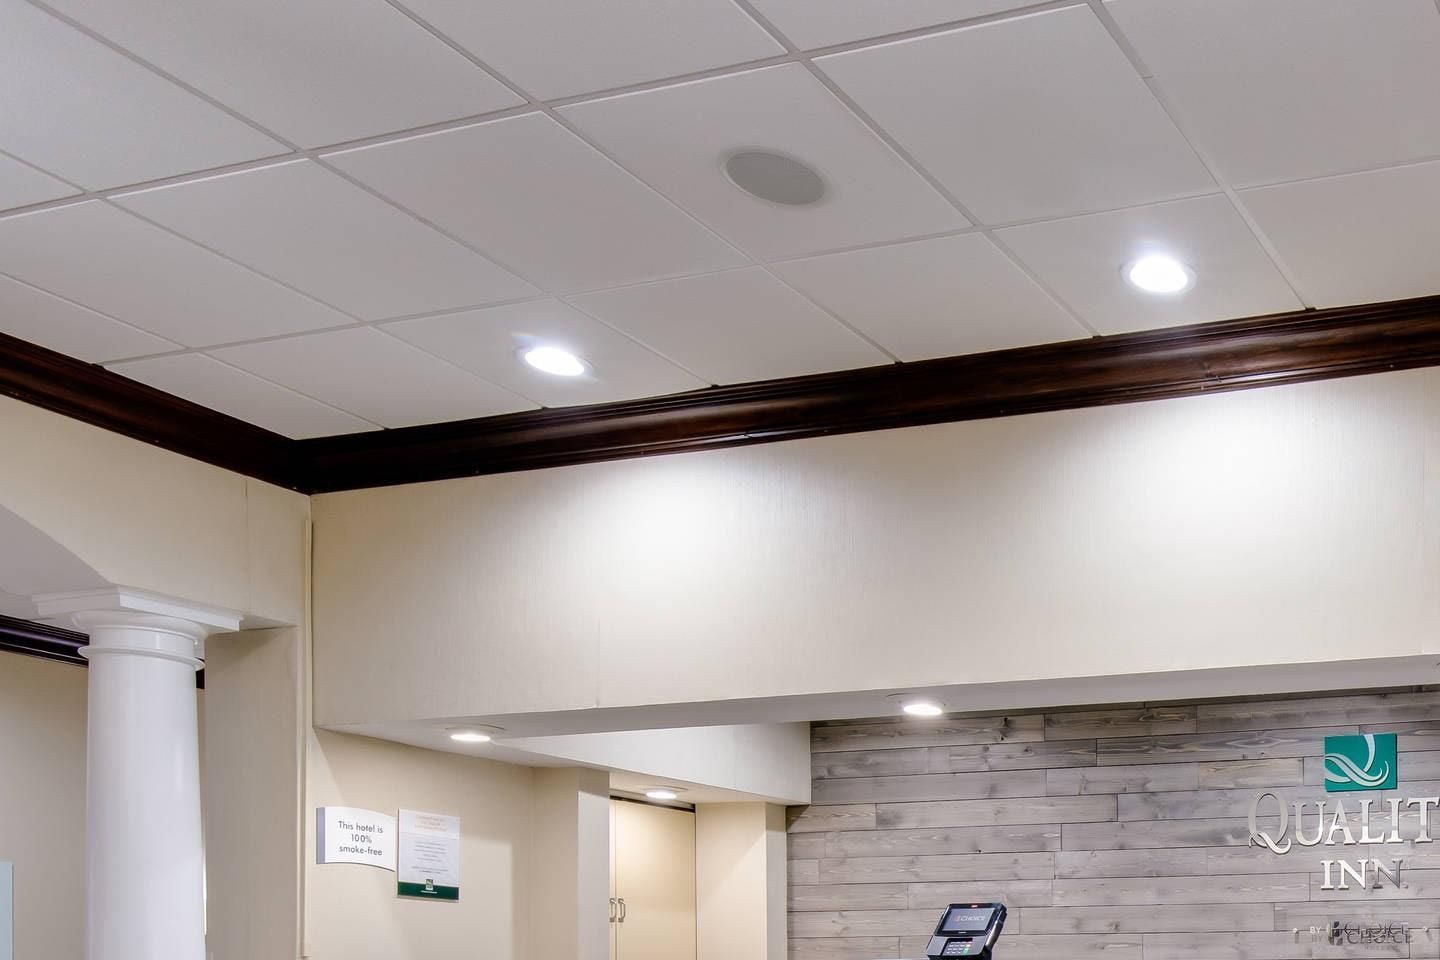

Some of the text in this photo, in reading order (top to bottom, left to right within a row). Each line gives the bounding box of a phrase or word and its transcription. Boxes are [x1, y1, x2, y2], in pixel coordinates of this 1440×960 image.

[338, 820, 384, 834] This hotel is
[351, 833, 373, 844] 100%
[339, 845, 383, 856] smoke-free
[1320, 859, 1403, 890] INN
